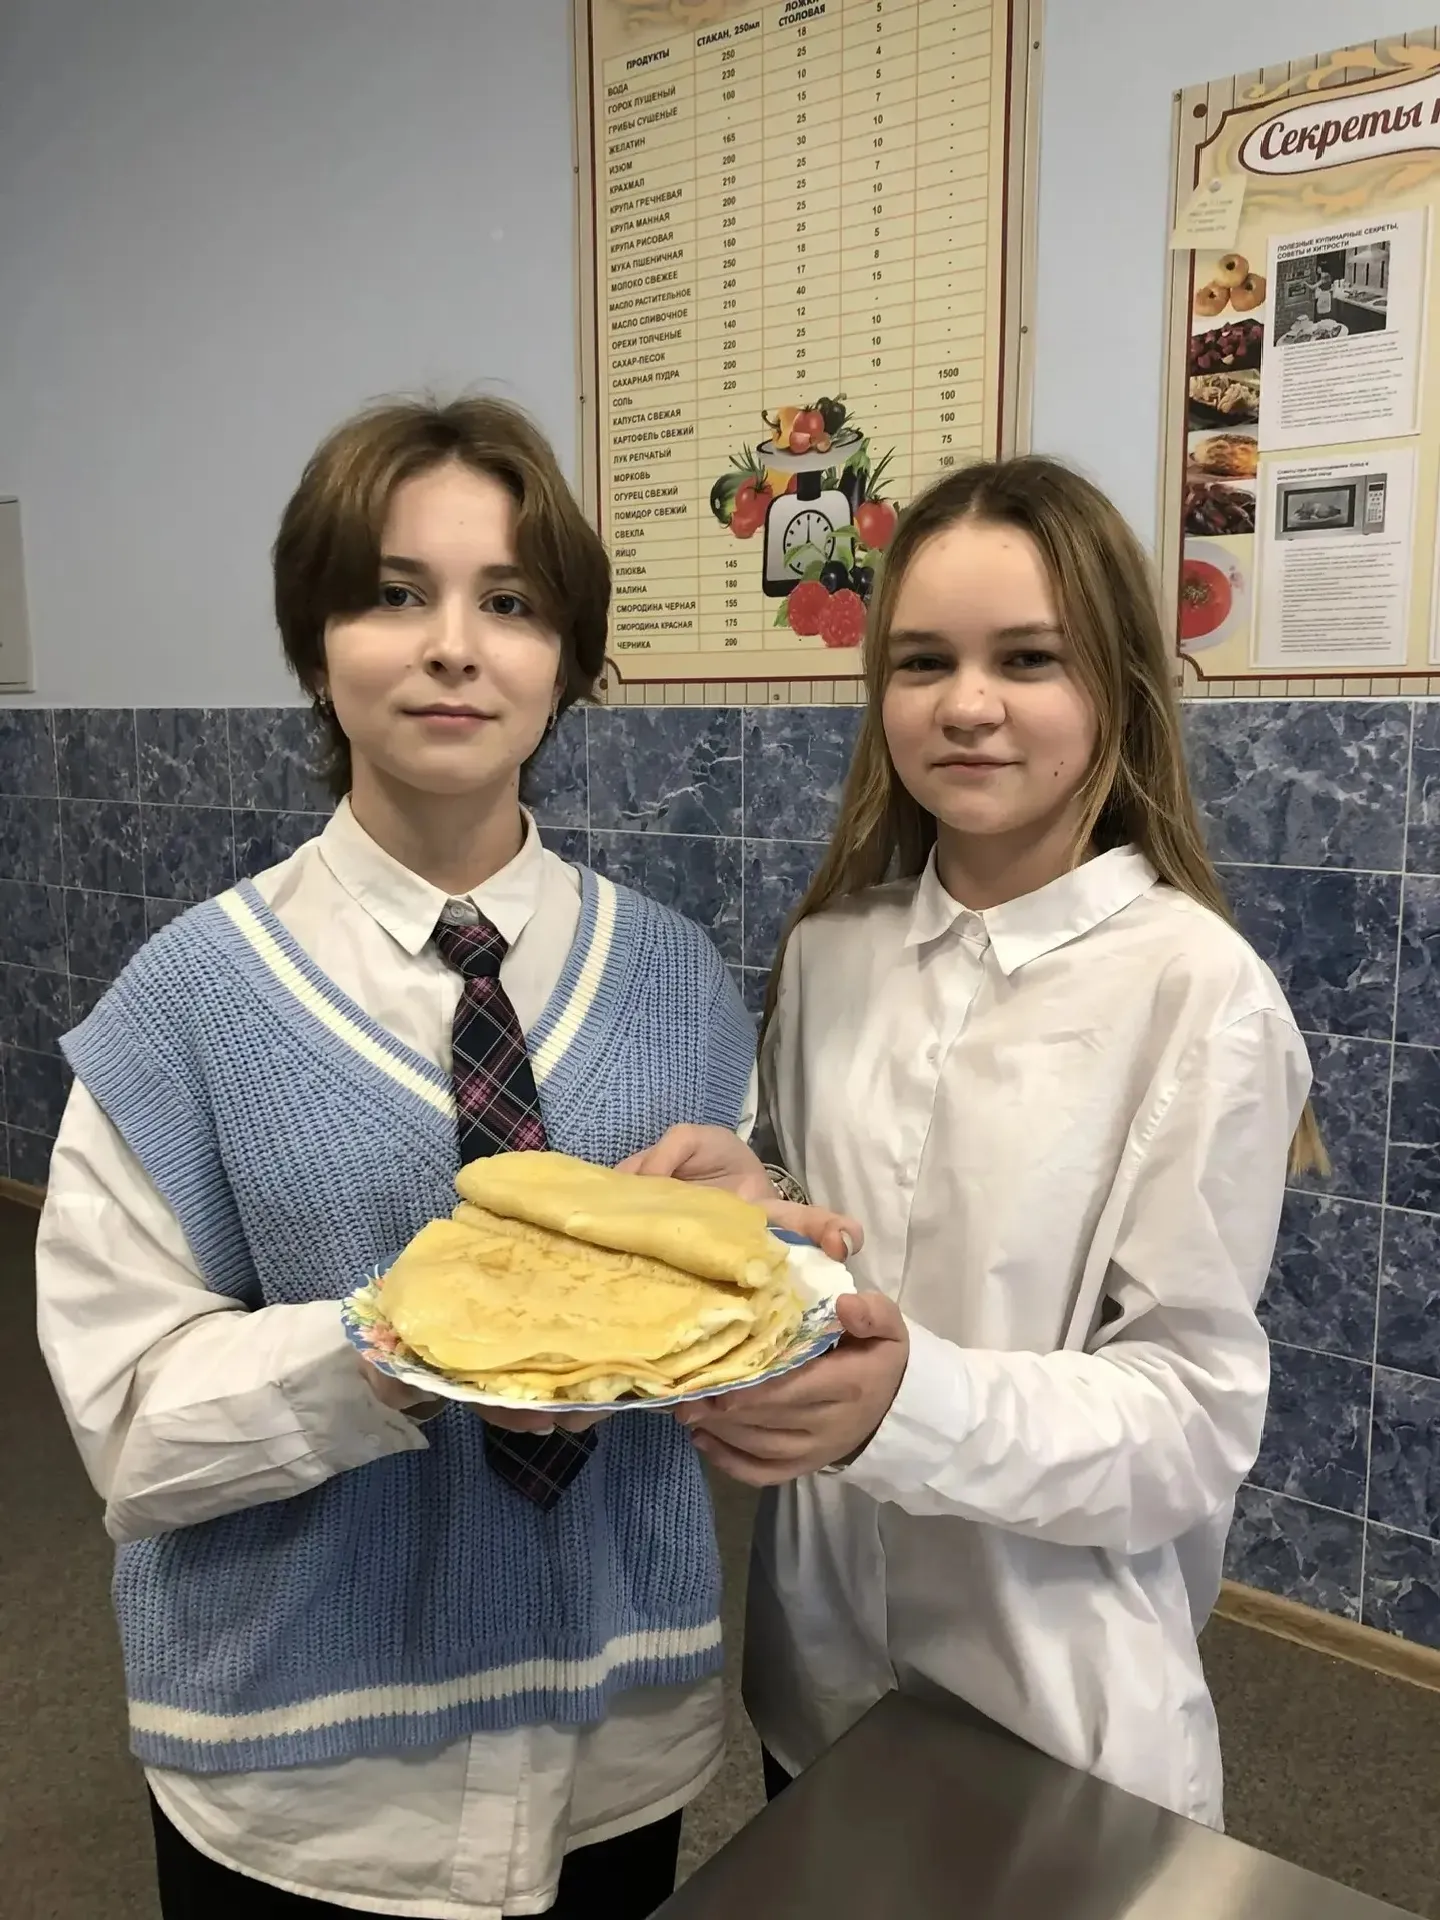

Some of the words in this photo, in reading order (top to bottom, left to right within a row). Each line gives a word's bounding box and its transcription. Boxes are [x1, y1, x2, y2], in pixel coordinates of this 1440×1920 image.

[876, 2, 882, 13] 5
[778, 3, 826, 27] СТОЛОВАЯ
[797, 26, 807, 37] 18
[876, 22, 882, 33] 5
[696, 28, 732, 47] СТАКАН,
[734, 21, 760, 36] 250мл
[721, 49, 736, 62] 250
[796, 45, 807, 58] 25
[875, 45, 882, 55] 4
[626, 48, 670, 70] ПРОДУКТЫ
[722, 68, 736, 81] 230
[797, 68, 807, 79] 10
[875, 68, 882, 79] 5
[607, 83, 629, 97] ВОДА
[722, 90, 736, 101] 100
[797, 90, 807, 101] 15
[875, 92, 881, 102] 7
[608, 100, 633, 114] ГОРОХ
[608, 119, 636, 135] ГРИБЫ
[636, 106, 678, 126] СУШЕНЫЕ
[796, 112, 807, 124] 25
[873, 114, 884, 125] 10
[1260, 102, 1423, 160] Секреты
[722, 132, 736, 143] 165
[796, 135, 807, 146] 30
[873, 137, 883, 148] 10
[608, 137, 646, 155] ЖЕЛАТИН
[722, 153, 736, 166] 200
[796, 157, 807, 168] 25
[875, 160, 881, 170] 7
[609, 161, 633, 175] ИЗЮМ
[609, 177, 645, 194] КРАХМАЛ
[722, 175, 736, 187] 210
[796, 178, 807, 189] 25
[872, 182, 883, 193] 10
[610, 201, 634, 214] КРУПА
[635, 188, 683, 208] ГРЕЧНЕВАЯ
[722, 195, 736, 208] 200
[796, 200, 807, 211] 25
[872, 204, 883, 215] 10
[610, 221, 635, 234] КРУПА
[636, 211, 670, 228] МАННАЯ
[722, 216, 736, 228] 230
[796, 221, 806, 232] 25
[874, 227, 880, 237] 5
[610, 240, 635, 253] КРУПА
[636, 231, 674, 247] РИСОВАЯ
[1278, 238, 1313, 252] ПОЛЕЗНЫЕ
[797, 243, 806, 253] 18
[874, 249, 880, 259] 8
[1277, 249, 1305, 260] СОВЕТЫ
[610, 261, 632, 273] МУКА
[632, 249, 684, 268] ПШЕНИЧНАЯ
[723, 258, 737, 269] 250
[797, 264, 806, 274] 17
[611, 277, 644, 292] МОЛОКО
[644, 270, 678, 285] СВЕЖЕЕ
[872, 270, 882, 281] 15
[723, 278, 737, 290] 240
[796, 285, 806, 296] 40
[609, 299, 634, 312] МАСЛО
[634, 288, 691, 307] РАСТИТЕЛЬНОЕ
[723, 299, 737, 310] 210
[796, 306, 806, 316] 12
[611, 318, 638, 331] МАСЛО
[639, 308, 688, 325] СЛИВОЧНОЕ
[723, 319, 737, 329] 140
[871, 314, 882, 324] 10
[796, 327, 806, 338] 25
[611, 338, 638, 350] ОРЕХИ
[639, 329, 682, 345] ТОЛЧЕНЫЕ
[723, 339, 737, 350] 220
[871, 336, 882, 346] 10
[796, 348, 806, 359] 25
[612, 352, 665, 369] САХАР-ПЕСОК
[723, 360, 737, 370] 200
[871, 357, 882, 367] 10
[612, 373, 653, 388] САХАРНАЯ
[655, 369, 680, 381] ПУДРА
[796, 369, 806, 379] 30
[938, 367, 959, 379] 1500
[723, 380, 737, 391] 220
[940, 389, 956, 401] 100
[612, 397, 633, 407] СОЛЬ
[612, 413, 646, 426] КАПУСТА
[647, 408, 681, 421] СВЕЖАЯ
[940, 411, 955, 422] 100
[613, 431, 659, 445] КАРТОФЕЛЬ
[660, 425, 694, 439] СВЕЖИЙ
[941, 434, 953, 444] 75
[613, 455, 628, 464] ЛУК
[629, 449, 672, 462] РЕПЧАТЫЙ
[613, 471, 651, 483] МОРКОВЬ
[613, 491, 644, 502] ОГУРЕЦ
[644, 487, 679, 499] СВЕЖИЙ
[614, 508, 652, 520] ПОМИДОР
[653, 504, 687, 517] СВЕЖИЙ
[614, 528, 645, 539] СВЕКЛА
[615, 548, 637, 558] ЯЙЦО
[725, 559, 738, 569] 145
[616, 566, 647, 576] КЛЮКВА
[725, 579, 738, 588] 180
[616, 585, 648, 594] МАЛИНА
[616, 603, 663, 613] СМОРОДИНА
[664, 601, 696, 611] ЧЕРНАЯ
[725, 598, 738, 608] 155
[616, 622, 660, 631] СМОРОДИНА
[660, 620, 693, 629] КРАСНАЯ
[725, 618, 738, 627] 175
[617, 640, 651, 650] ЧЕРНИКА
[724, 637, 738, 647] 200
